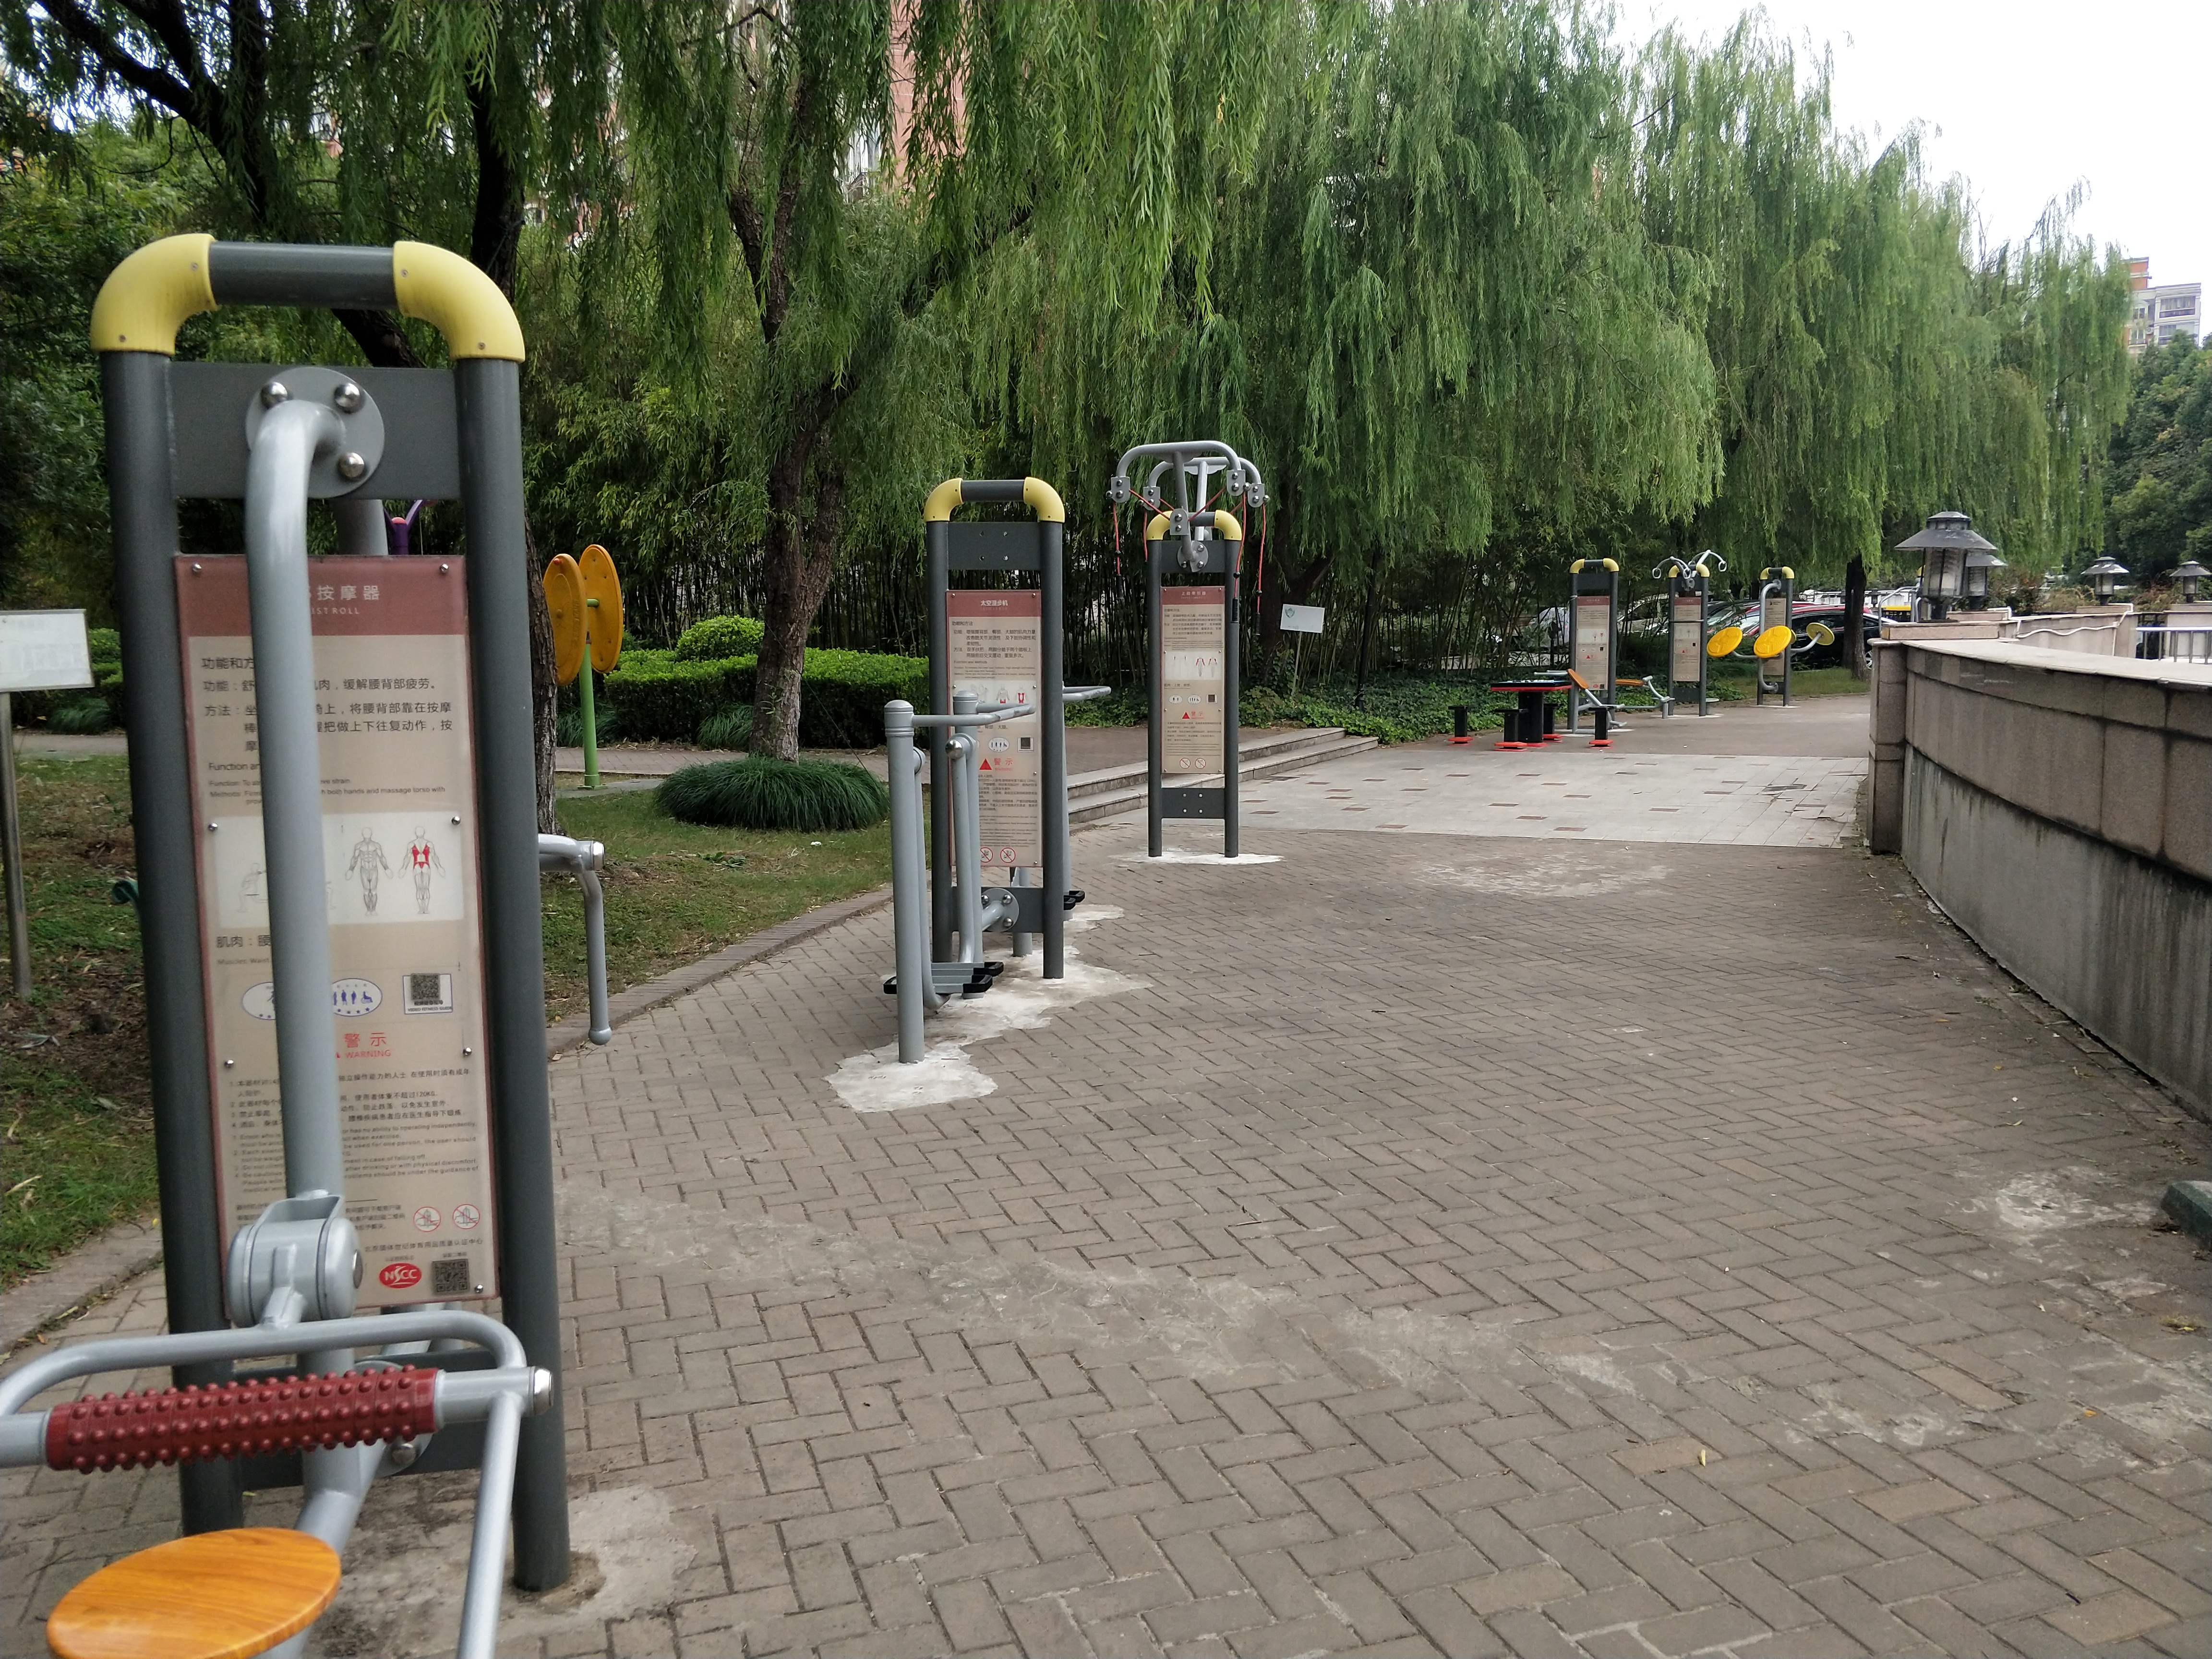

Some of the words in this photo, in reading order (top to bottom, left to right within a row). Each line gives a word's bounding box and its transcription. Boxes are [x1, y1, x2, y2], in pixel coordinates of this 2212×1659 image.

[309, 585, 379, 601] 按摩器
[208, 762, 248, 770] Function
[994, 757, 1013, 766] 警示
[343, 1032, 387, 1048] 警示
[345, 1049, 391, 1059] WARNING
[385, 1266, 417, 1284] NSCC
